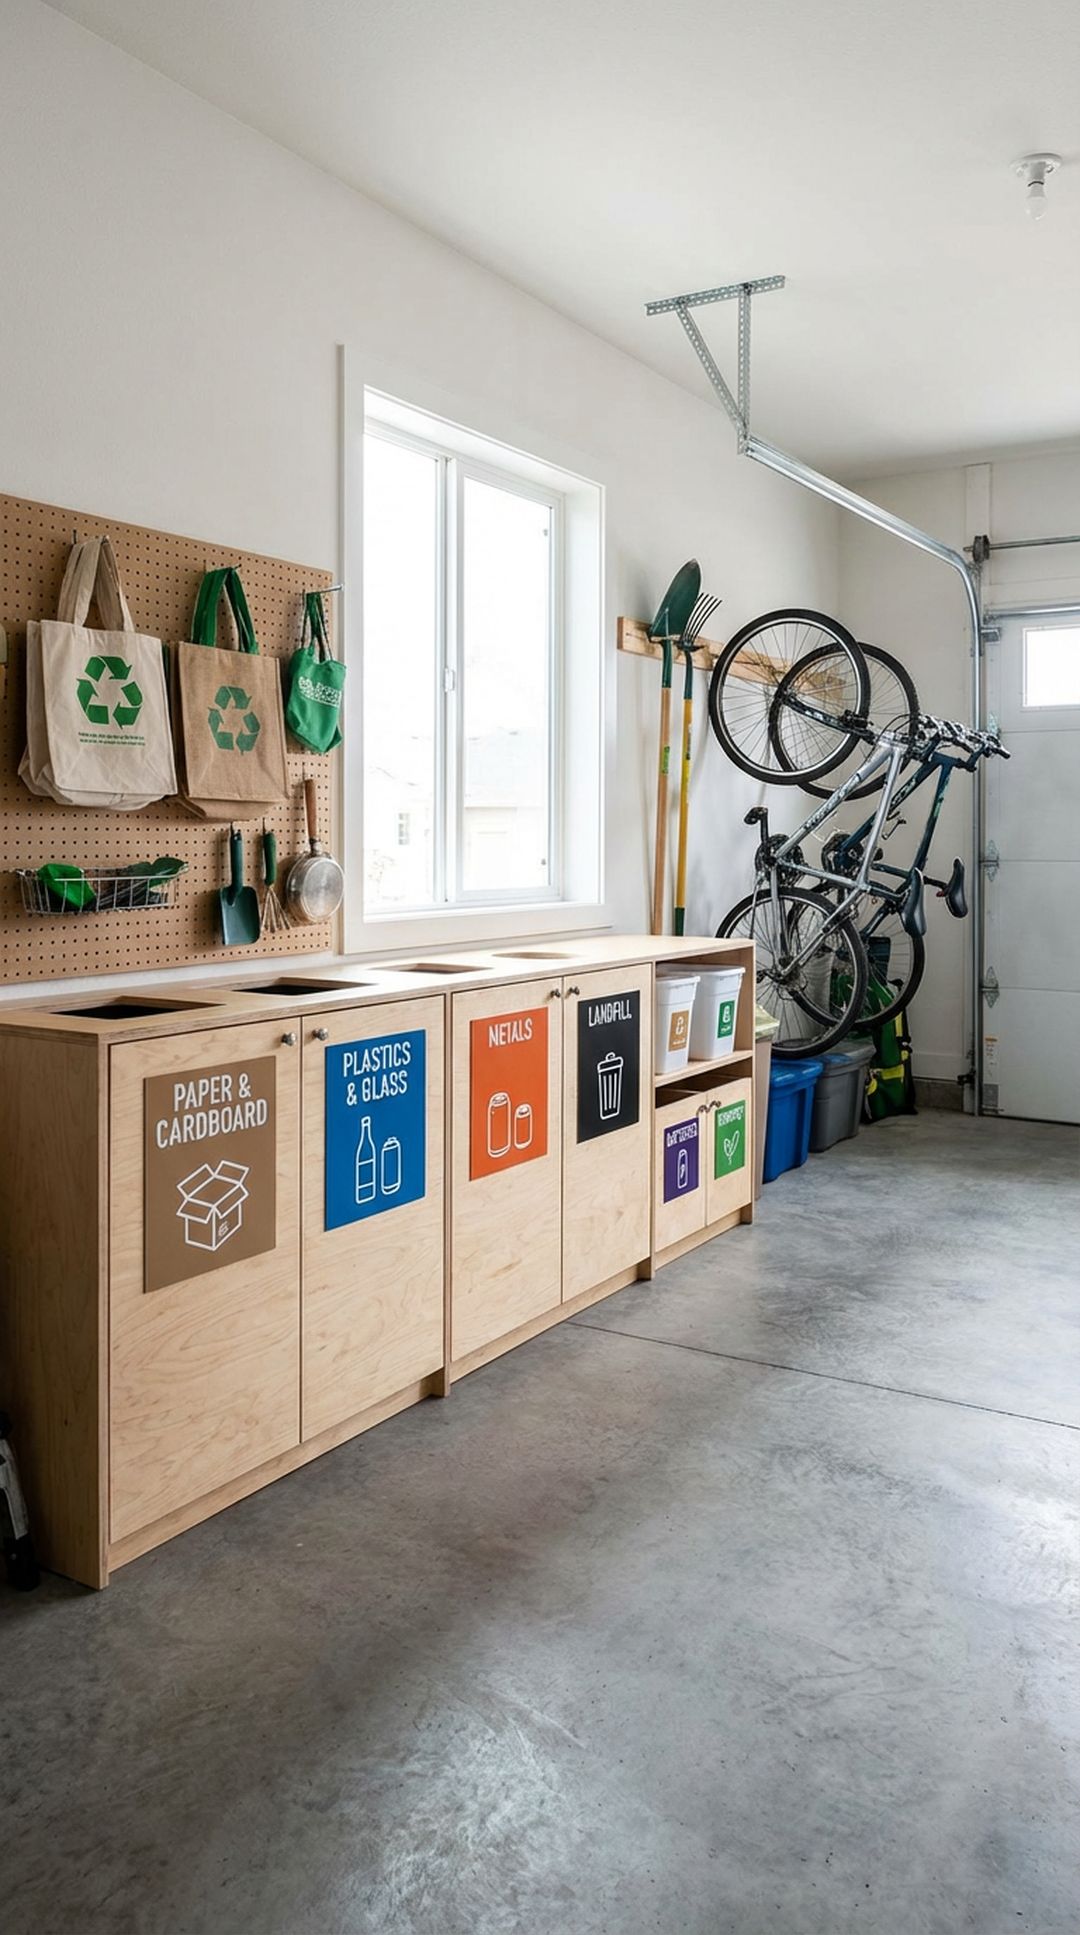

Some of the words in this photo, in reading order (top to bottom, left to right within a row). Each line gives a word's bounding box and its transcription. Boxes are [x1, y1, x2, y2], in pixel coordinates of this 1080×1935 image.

[343, 1041, 411, 1077] PLASTICS
[174, 1074, 232, 1112] PAPER
[238, 1072, 251, 1098] &
[346, 1082, 358, 1106] &
[156, 1098, 268, 1148] CARDBOARD
